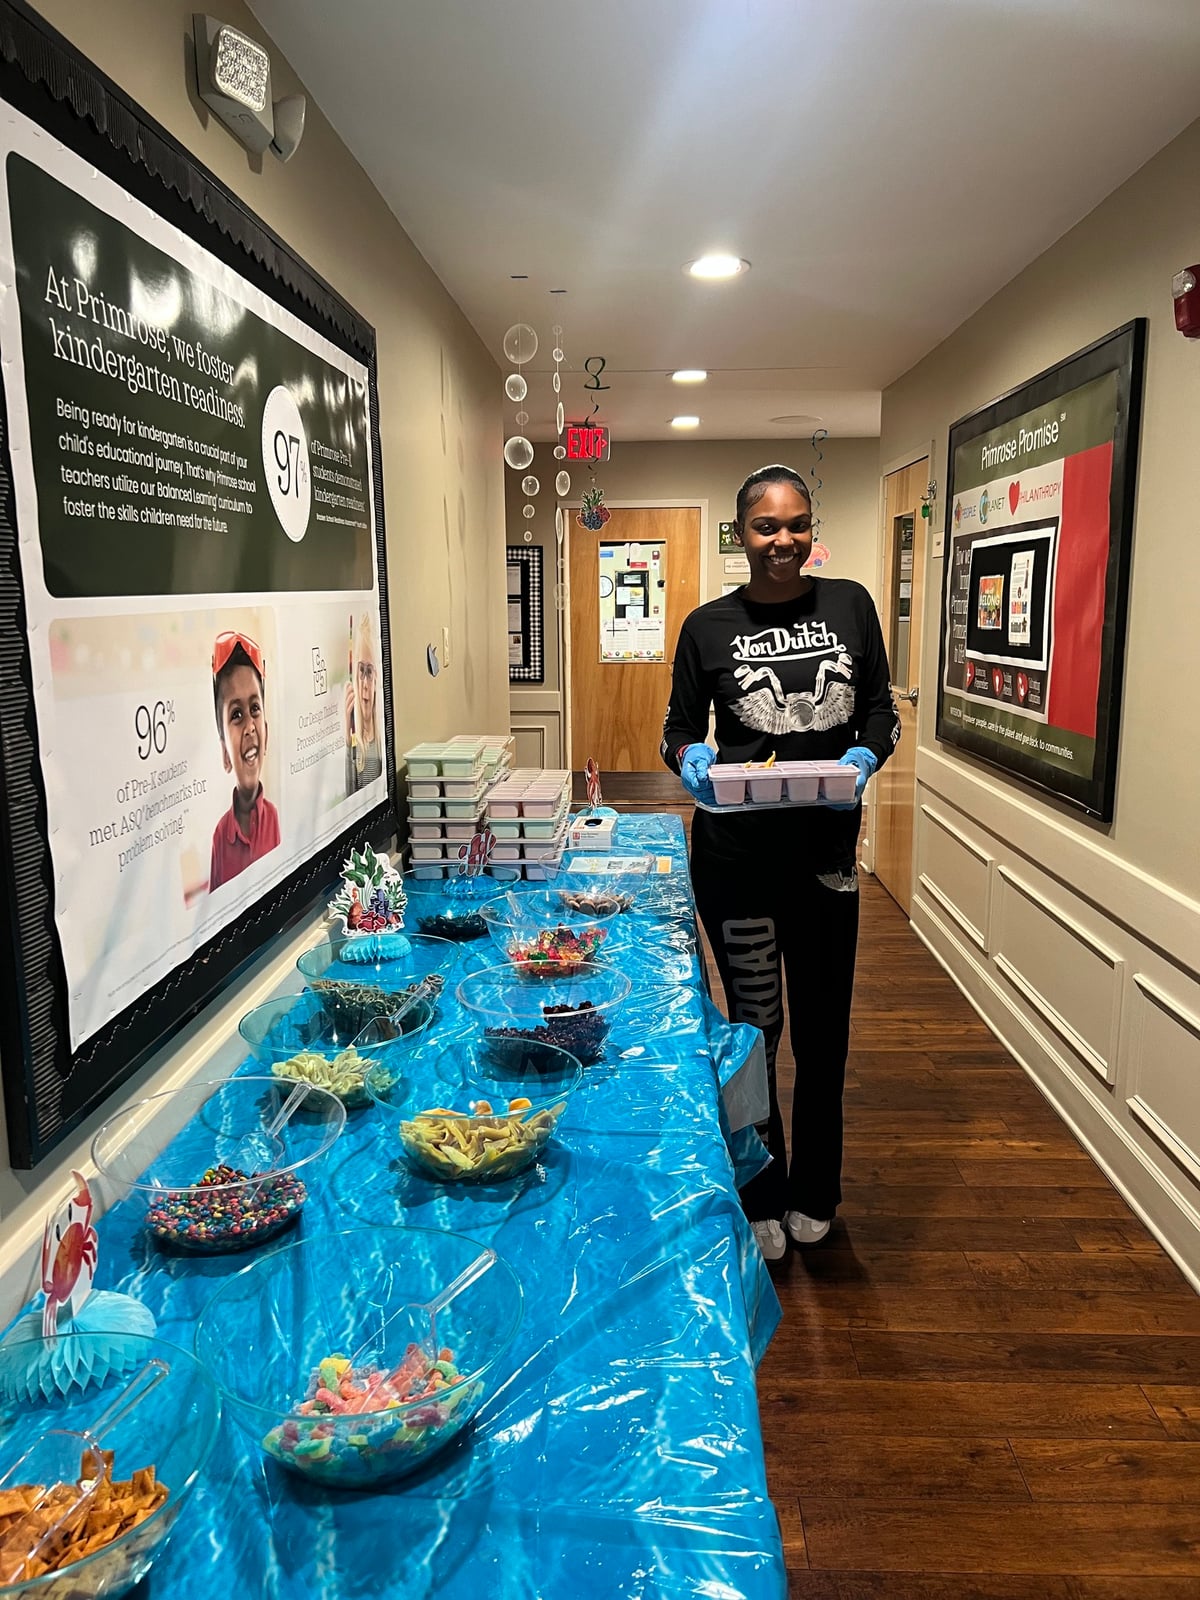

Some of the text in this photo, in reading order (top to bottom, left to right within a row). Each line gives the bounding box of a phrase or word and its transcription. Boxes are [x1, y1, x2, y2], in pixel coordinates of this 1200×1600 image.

[45, 265, 235, 387] At Primrose, we foster
[49, 317, 246, 429] kindergarten readiness.
[56, 397, 248, 470] Being ready for kindergarten is a crucial part of your
[567, 428, 604, 459] EXIT
[981, 439, 1016, 471] Primrose
[1018, 419, 1059, 457] Promise
[58, 432, 257, 493] child's educational journey. That's why Primrose school
[60, 464, 110, 490] teachers
[111, 474, 139, 494] utilize
[140, 481, 155, 497] our
[157, 481, 192, 503] Balanced
[246, 501, 253, 514] to
[63, 496, 95, 518] foster
[98, 501, 116, 520] the
[117, 503, 139, 523] skills
[140, 507, 176, 526] children
[176, 513, 194, 529] need
[194, 513, 203, 530] for
[203, 515, 212, 531] the
[730, 621, 838, 658] Von Dutch
[1039, 739, 1045, 750] to
[116, 760, 188, 804] of Pre-K students
[89, 822, 118, 847] met
[193, 778, 207, 797] for
[118, 832, 154, 873] problem
[722, 917, 779, 1027] ROAD
